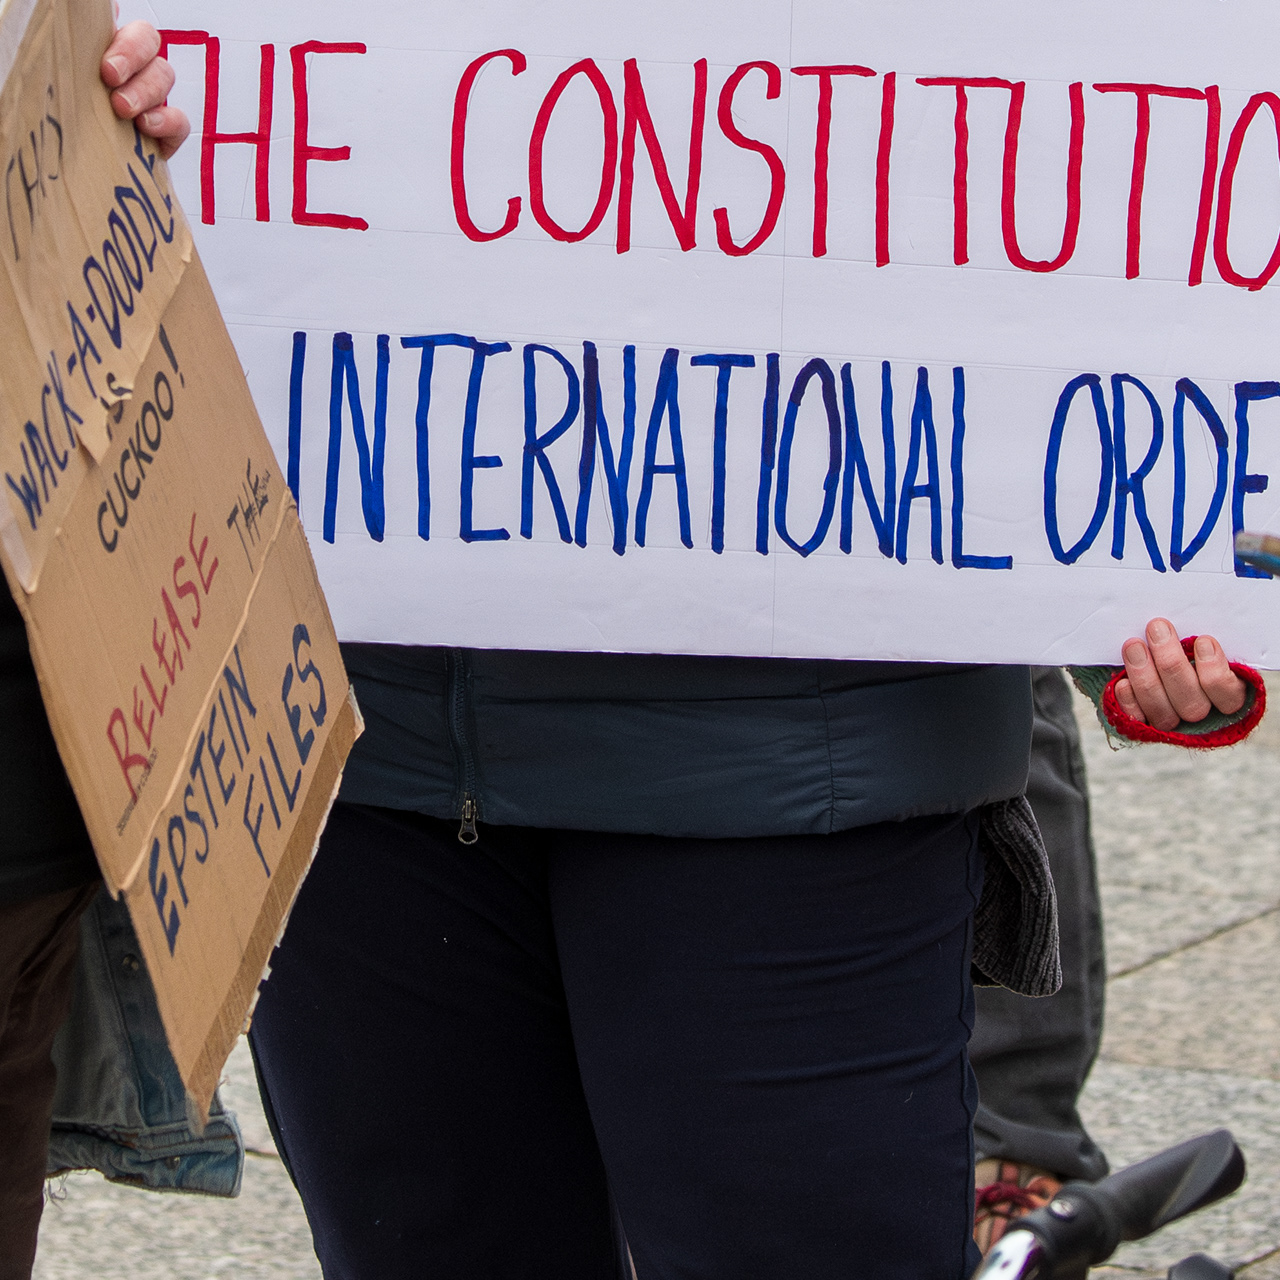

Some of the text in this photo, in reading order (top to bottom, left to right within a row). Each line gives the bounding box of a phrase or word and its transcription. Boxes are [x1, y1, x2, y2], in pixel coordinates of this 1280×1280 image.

[5, 83, 64, 263] THIS
[4, 118, 176, 532] WACK-A-DOODLE
[97, 322, 186, 554] CUCKOO!
[286, 331, 1013, 570] INTERNATIONAL
[106, 510, 220, 806] RELEASE
[225, 457, 270, 575] THE
[242, 622, 328, 880] FILES
[148, 642, 258, 959] EPSTEIN
